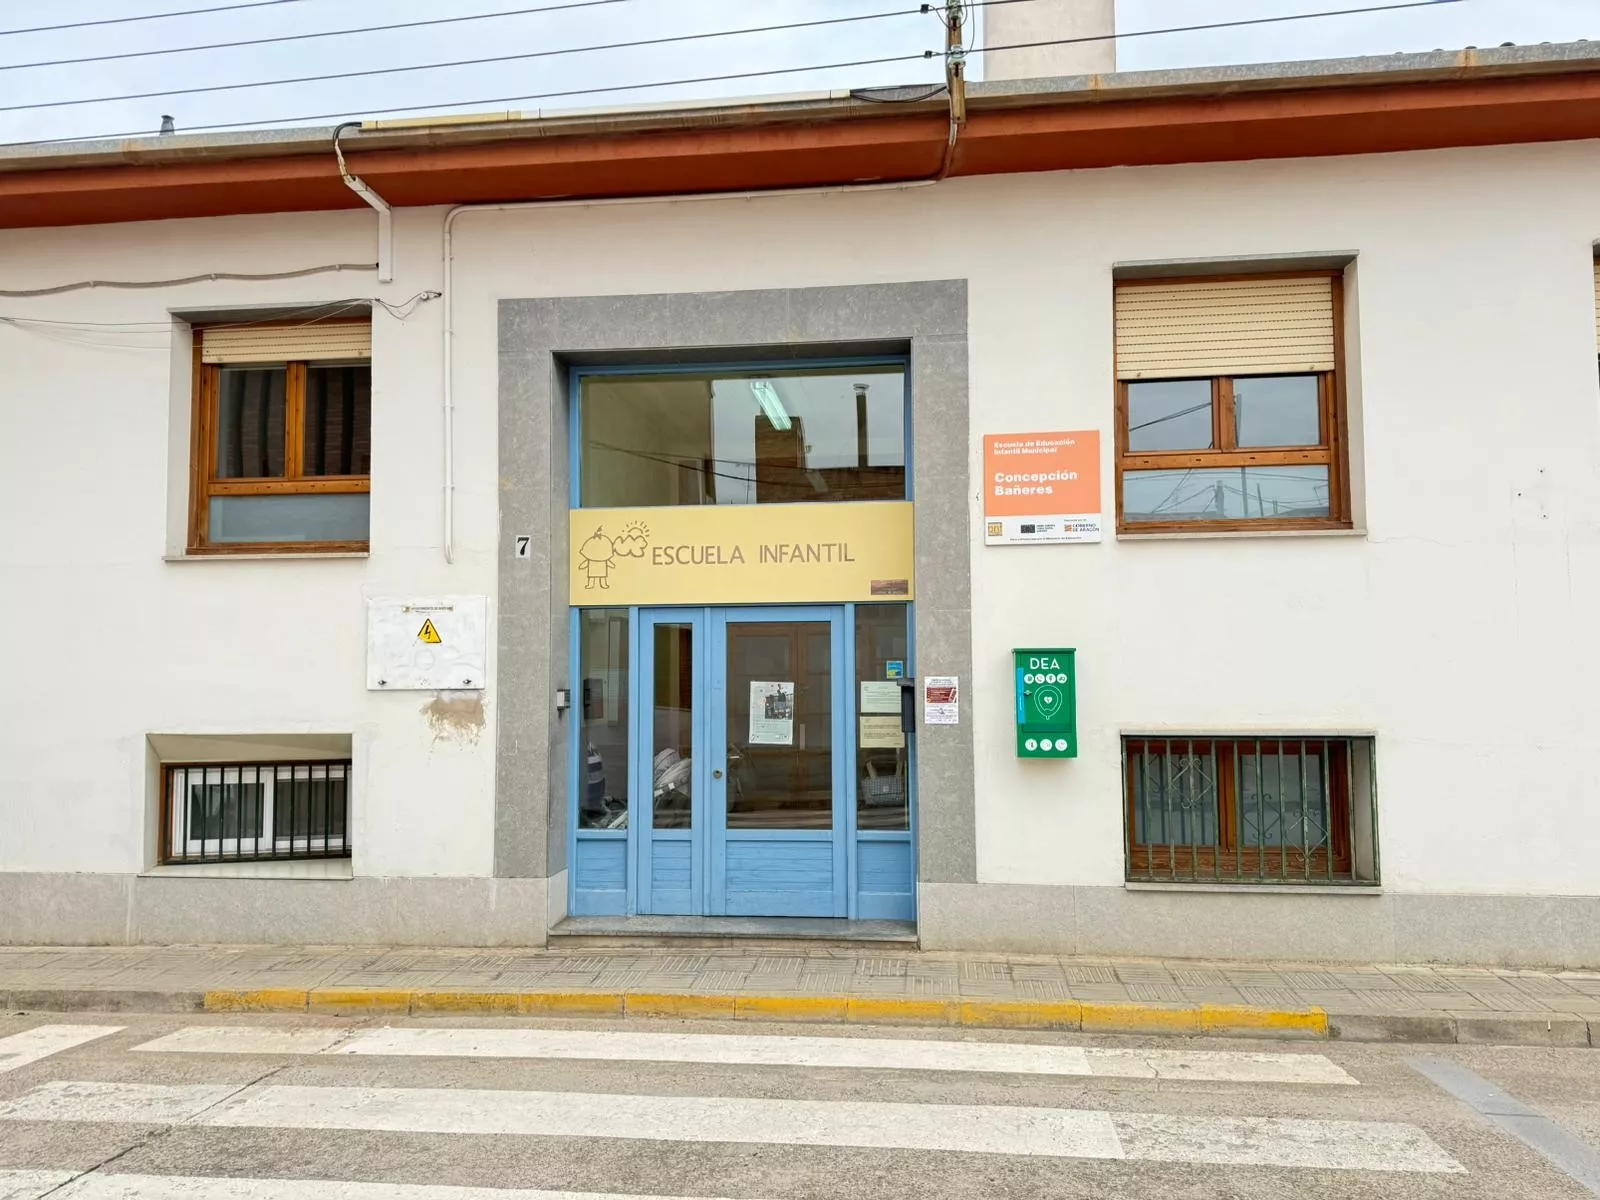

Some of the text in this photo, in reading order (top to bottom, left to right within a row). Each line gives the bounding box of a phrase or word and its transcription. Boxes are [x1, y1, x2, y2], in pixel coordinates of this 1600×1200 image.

[1036, 438, 1075, 447] Educación
[1021, 446, 1057, 454] Municipal
[994, 470, 1078, 483] Concepción
[994, 483, 1053, 496] Bañeres
[517, 537, 530, 556] 7
[652, 543, 855, 565] ESCUELA INFANTIL
[1029, 657, 1060, 670] DEA
